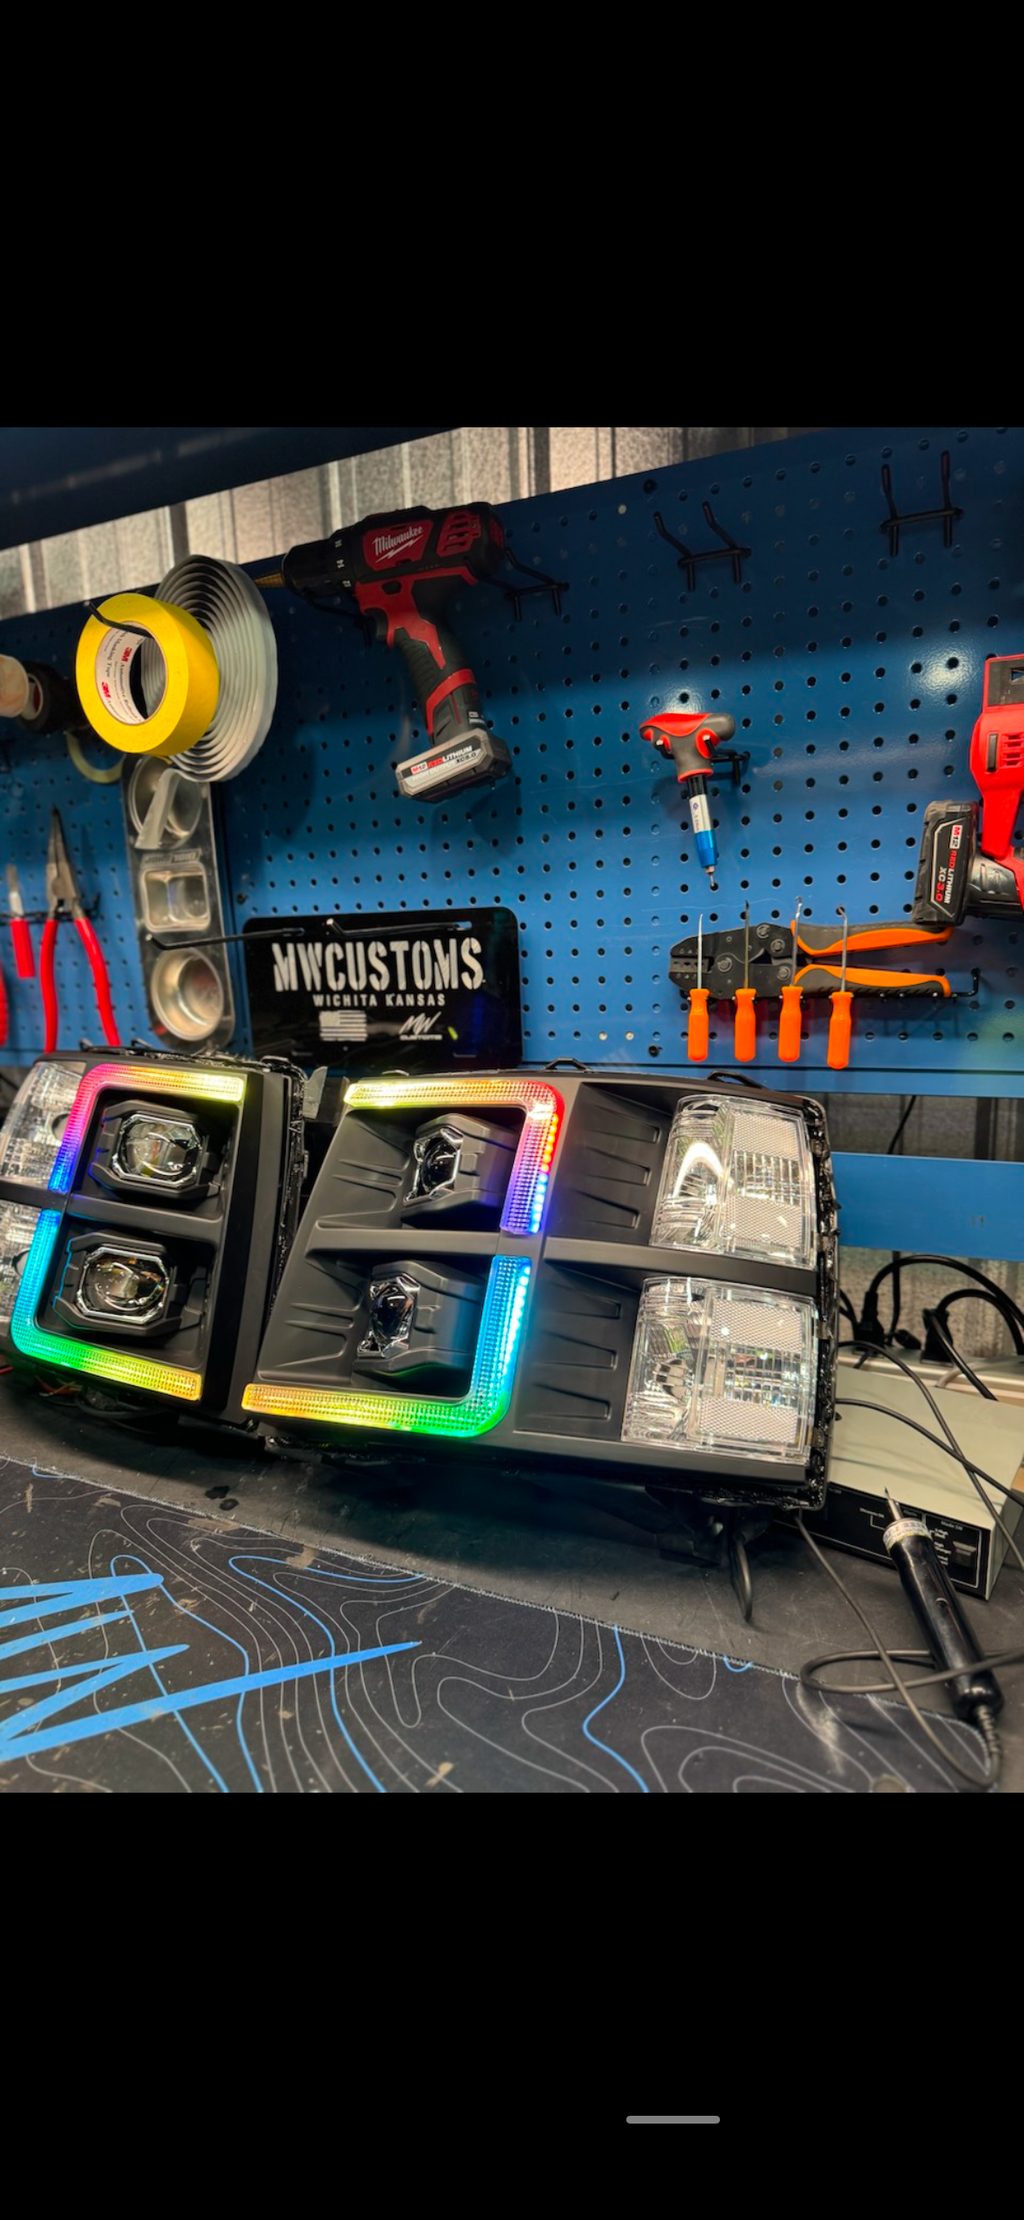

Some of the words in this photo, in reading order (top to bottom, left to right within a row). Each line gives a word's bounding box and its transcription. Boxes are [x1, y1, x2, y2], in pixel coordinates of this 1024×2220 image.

[372, 526, 423, 556] Milwaukee
[121, 646, 133, 663] 3M
[101, 681, 112, 699] 3M
[951, 825, 962, 848] M12
[944, 850, 957, 904] REDLITHIUM
[271, 937, 484, 992] MWCUSTOMS
[313, 993, 378, 1007] WICHITA
[385, 993, 446, 1007] KANSAS
